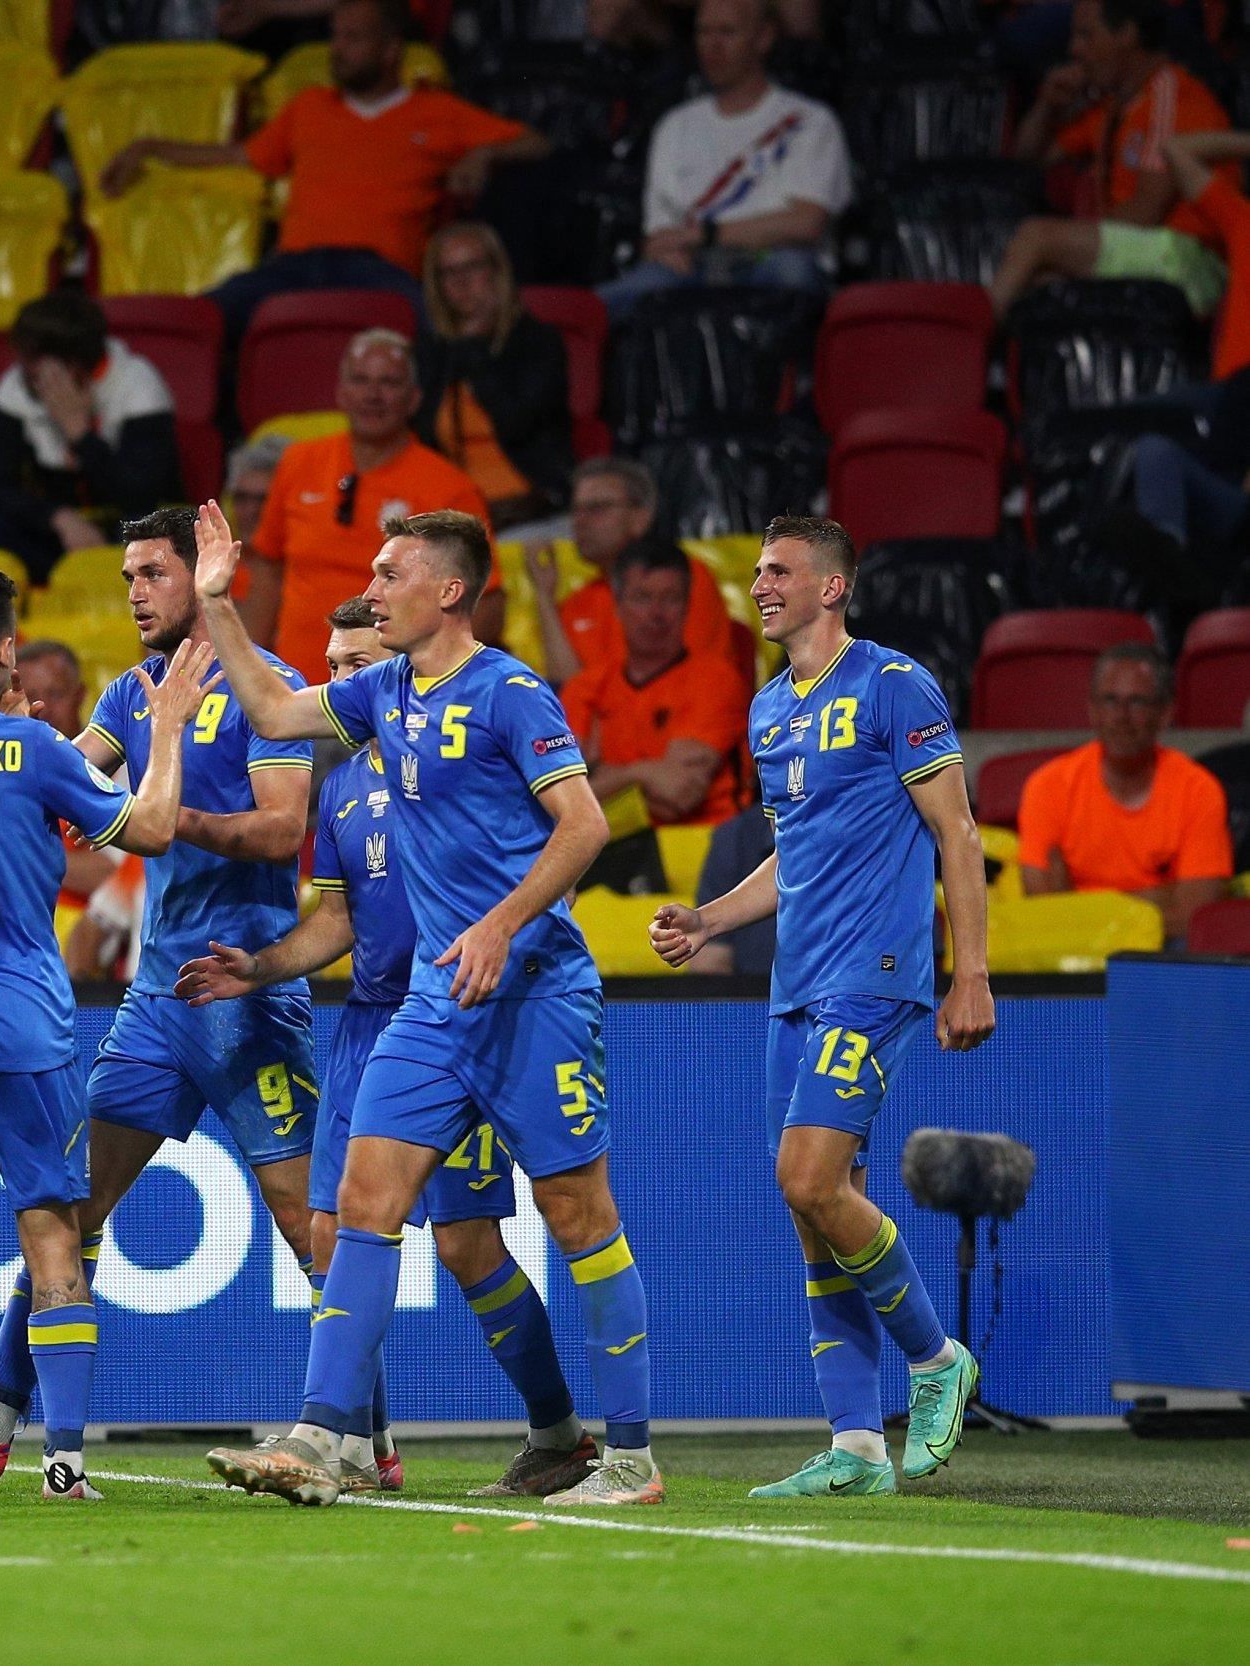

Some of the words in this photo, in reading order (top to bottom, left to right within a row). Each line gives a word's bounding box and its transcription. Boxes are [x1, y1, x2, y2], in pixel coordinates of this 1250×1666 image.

[193, 692, 229, 744] 9
[439, 704, 473, 760] 5
[545, 734, 576, 749] RESPECT
[818, 696, 859, 753] 13
[920, 721, 949, 739] RESPECT
[814, 1026, 870, 1083] 13
[255, 1061, 296, 1119] 9
[554, 1060, 588, 1118] 5
